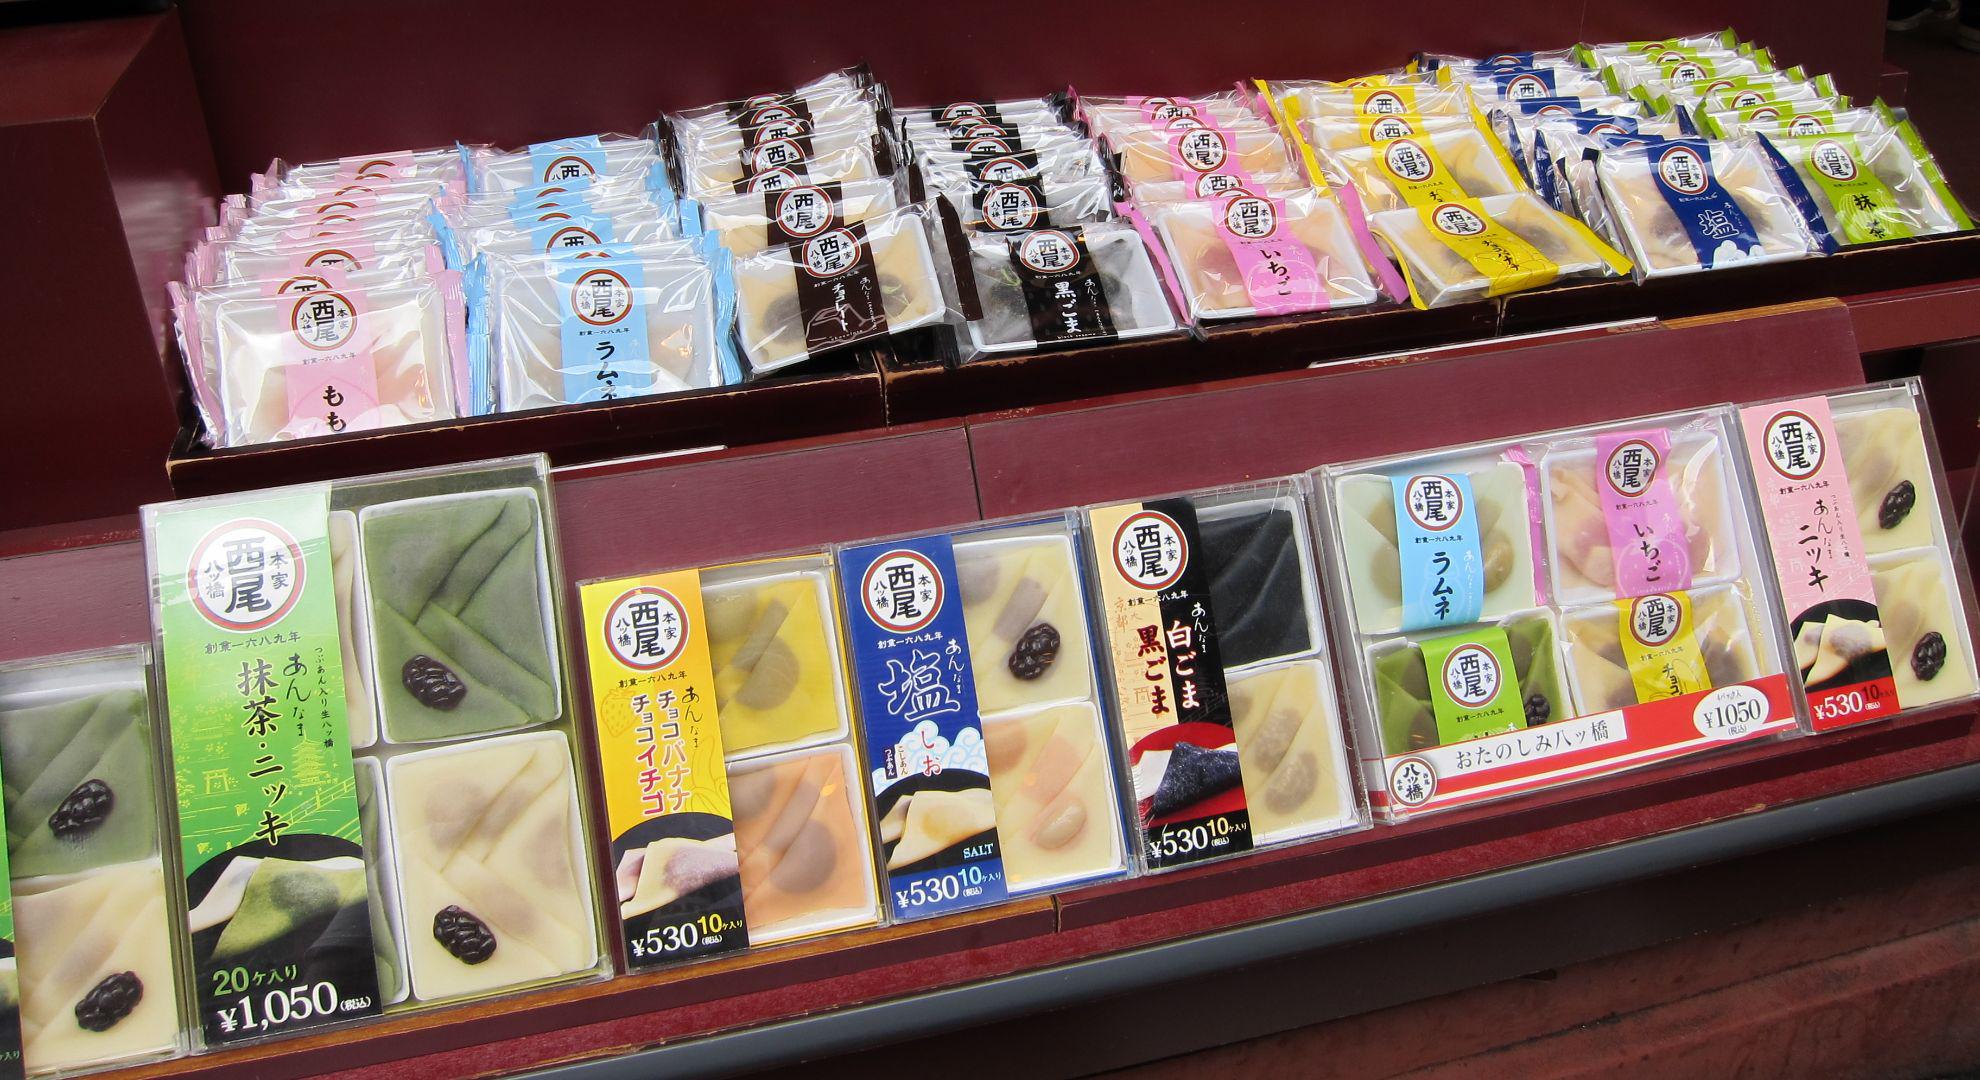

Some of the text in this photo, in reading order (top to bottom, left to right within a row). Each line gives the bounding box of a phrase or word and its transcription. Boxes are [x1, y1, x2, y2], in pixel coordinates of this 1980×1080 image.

[1376, 99, 1392, 113] 西
[1519, 83, 1535, 97] 西
[1166, 107, 1183, 118] 西
[1383, 124, 1400, 137] 西
[766, 145, 786, 164] 西
[1192, 134, 1214, 165] 西尾
[1395, 147, 1424, 176] 西尾
[1823, 148, 1849, 176] 西尾
[560, 165, 580, 180] 西
[761, 175, 781, 189] 西
[1209, 175, 1228, 191] 西
[1672, 155, 1698, 188] 西尾
[793, 193, 815, 229] 西尾
[1000, 192, 1022, 226] 西尾
[1239, 201, 1264, 234] 西尾
[1443, 210, 1477, 233] 西尾
[1698, 210, 1740, 240] 塩
[1853, 194, 1886, 239] 抹茶
[817, 235, 845, 272] 西尾
[1037, 239, 1064, 267] 西尾
[1260, 250, 1292, 296] いちご
[590, 279, 615, 318] 西尾
[1054, 281, 1081, 333] 黒ごま
[310, 300, 339, 342] 西尾
[596, 340, 619, 400] ラムネ
[323, 385, 347, 432] もも
[1771, 434, 1785, 460] 八ッ橋
[1779, 421, 1811, 470] 西尾
[1805, 432, 1818, 454] 本家
[1622, 449, 1643, 488] 西尾
[1421, 480, 1448, 521] 西尾
[1779, 481, 1830, 495] 創業一六八九年
[1814, 498, 1833, 559] あんなま
[1123, 540, 1137, 567] 八ッ橋
[1132, 523, 1168, 578] 西尾
[1164, 534, 1177, 562] 本家
[1633, 523, 1661, 582] いちご
[1798, 524, 1829, 593] ニッキ
[204, 560, 224, 599] 八ッ橋
[223, 536, 271, 614] 西尾
[270, 552, 289, 590] 本家
[1432, 551, 1453, 620] ラムネ
[874, 580, 889, 609] 八ッ橋
[885, 563, 921, 619] 西尾
[918, 575, 932, 603] 本家
[616, 617, 632, 647] 八ッ橋
[628, 599, 665, 658] 西尾
[662, 611, 677, 640] 本家
[1191, 602, 1208, 653] あんなま
[1643, 598, 1667, 638] 西尾
[204, 631, 301, 655] 創業一六八九年
[877, 632, 943, 649] 創業一六八九年
[618, 671, 687, 689] 創業一六八九年
[946, 639, 964, 694] あんなま
[1136, 624, 1170, 714] 黒ごま
[1166, 619, 1200, 709] 白ごま
[1458, 653, 1487, 698] 西尾
[1662, 663, 1683, 695] チョコ
[282, 652, 311, 737] あんなま
[878, 649, 961, 722] 塩
[682, 686, 703, 749] あんなま
[1703, 699, 1761, 728] ¥1050
[1813, 691, 1863, 720] ¥530
[237, 658, 289, 845] 抹茶・ニッキ
[632, 694, 664, 815] チョコイチゴ
[658, 690, 690, 811] チョコバナナ
[922, 730, 942, 776] しお
[1456, 720, 1609, 769] おたのしみ八ッ橋
[1403, 764, 1423, 801] 八ッ橋
[963, 843, 994, 859] SALT
[1149, 826, 1208, 858] ¥530
[896, 875, 959, 908] ¥530
[631, 923, 698, 957] ¥530
[701, 935, 723, 946] (税込)
[217, 981, 339, 1033] ¥1,050
[340, 996, 371, 1012] (税込)
